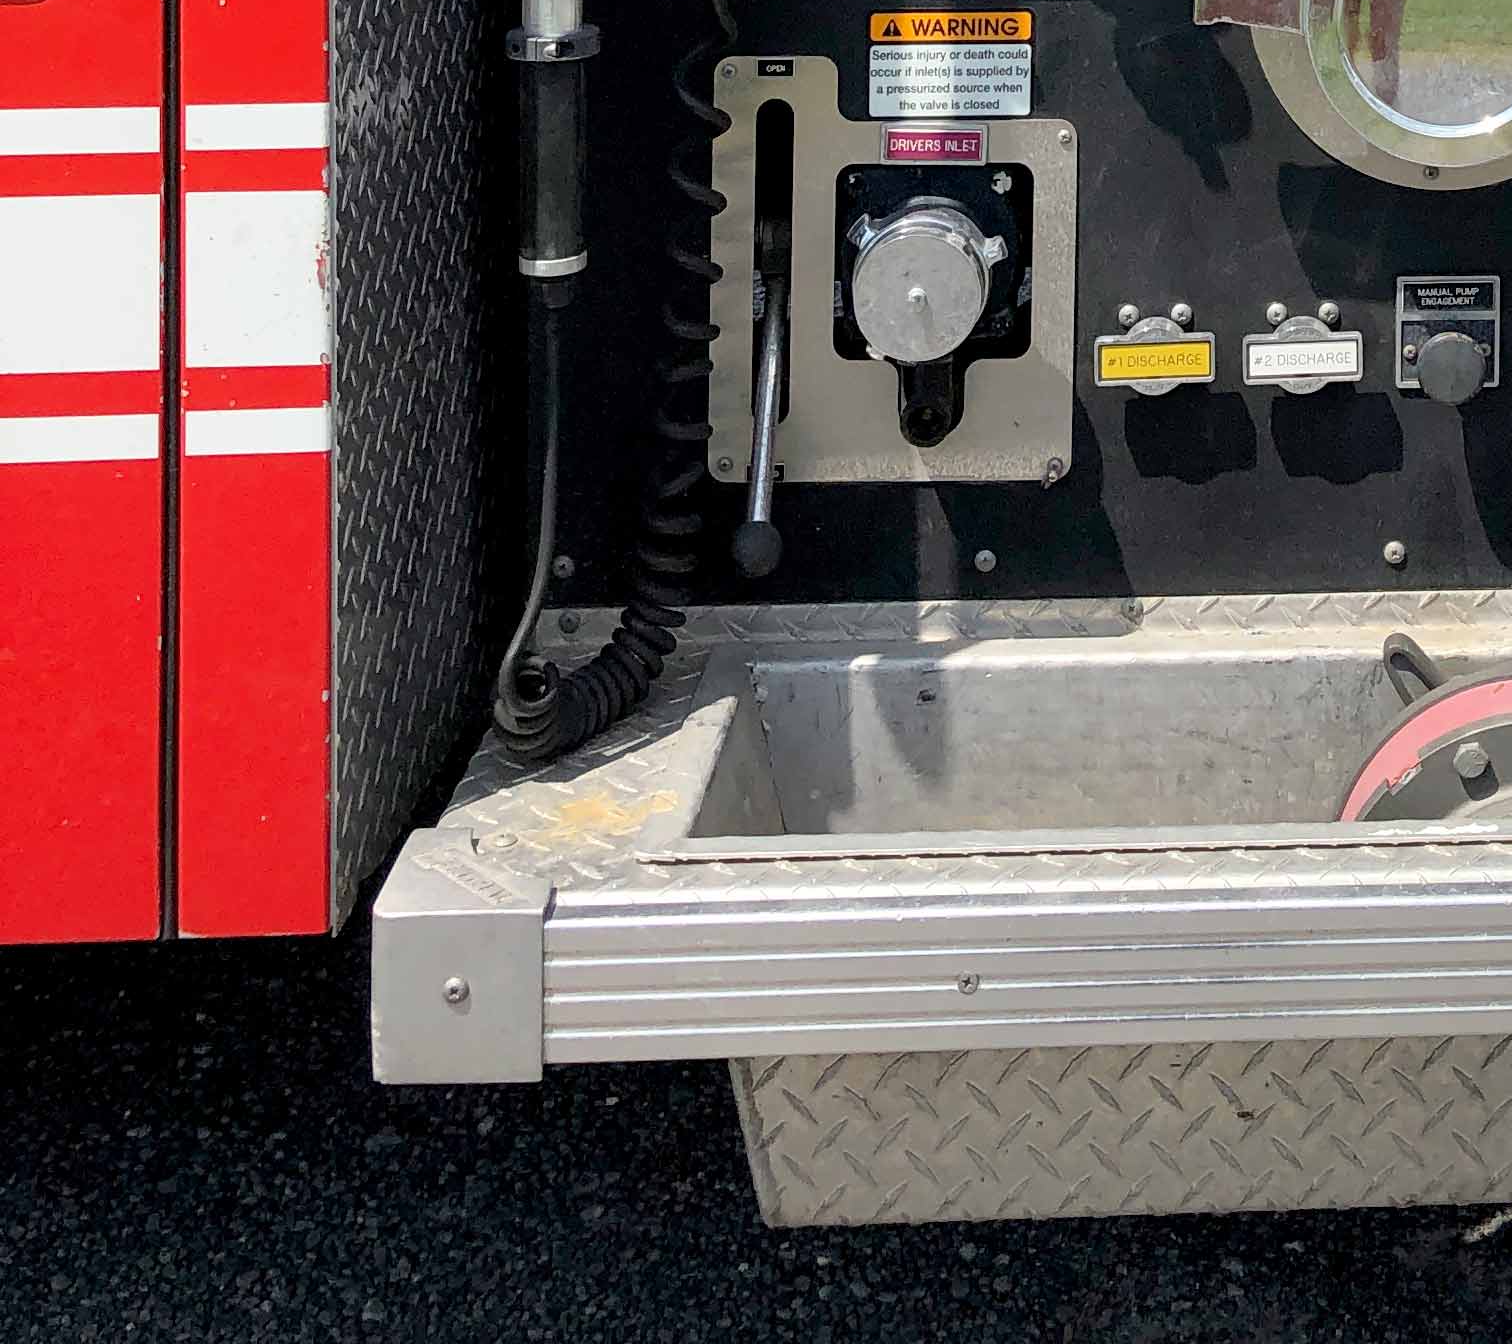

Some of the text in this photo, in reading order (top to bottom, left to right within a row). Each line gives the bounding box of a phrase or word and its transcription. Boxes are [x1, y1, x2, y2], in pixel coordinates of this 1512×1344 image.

[912, 18, 1019, 36] WARNING
[872, 49, 1028, 62] Serious injury or death could
[766, 64, 786, 72] OPEN
[871, 66, 1029, 78] occur if inlet(s) is supplied by
[886, 83, 950, 96] pressurized
[953, 84, 990, 93] source
[993, 83, 1022, 93] when
[899, 99, 1000, 110] the valve is closed
[890, 139, 978, 152] DRIVERS INLET
[1417, 287, 1480, 297] MANUAL PUMP
[1421, 297, 1475, 306] ENGAGEMENT
[1108, 353, 1202, 368] #1 DISCHARGE
[1254, 351, 1351, 367] #2 DISCHARGE
